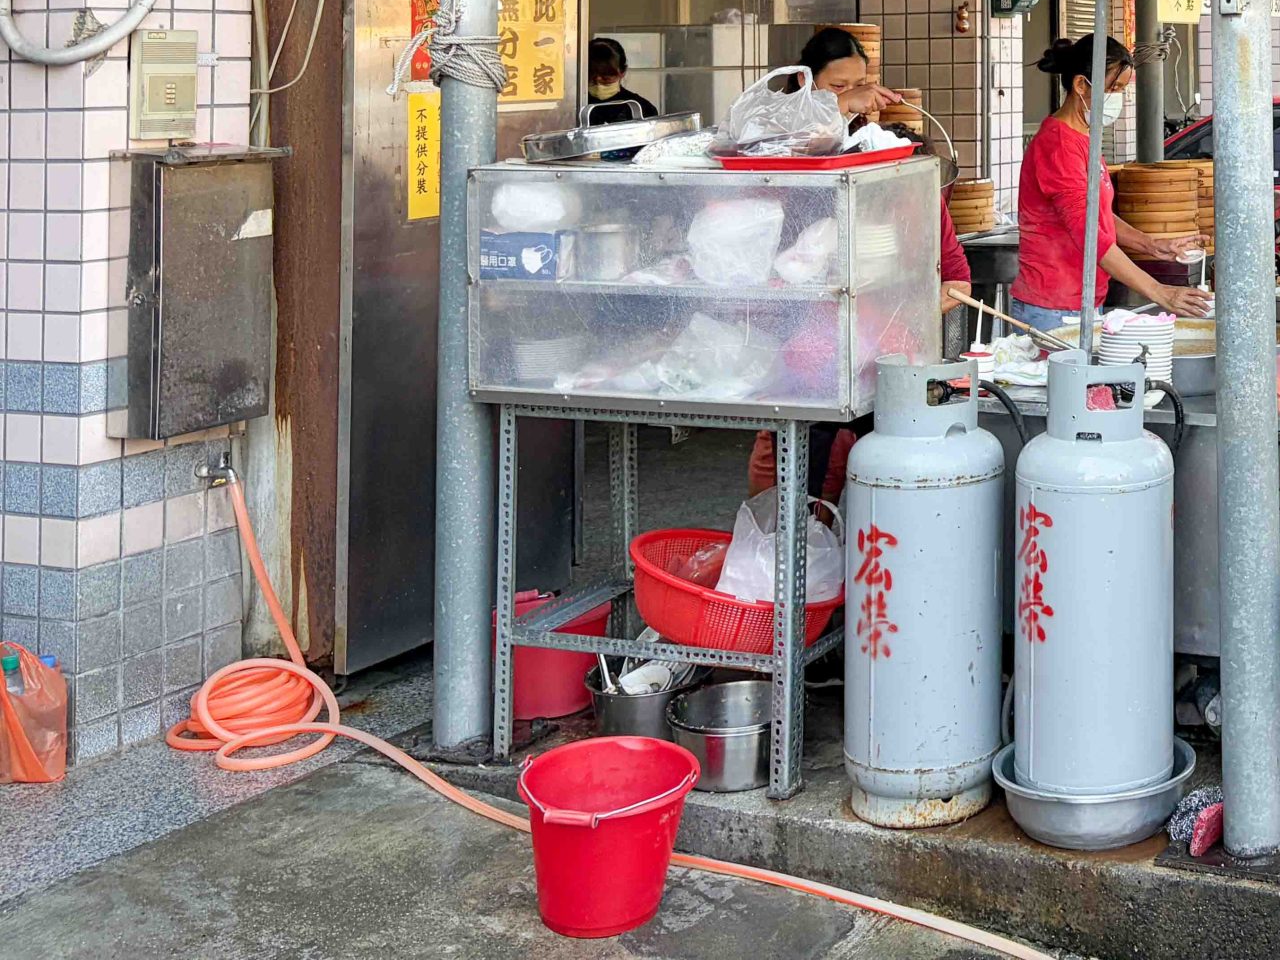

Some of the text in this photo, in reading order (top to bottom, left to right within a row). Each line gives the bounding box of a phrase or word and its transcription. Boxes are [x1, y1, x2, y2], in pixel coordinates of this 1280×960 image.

[415, 108, 429, 195] 不提供分裝
